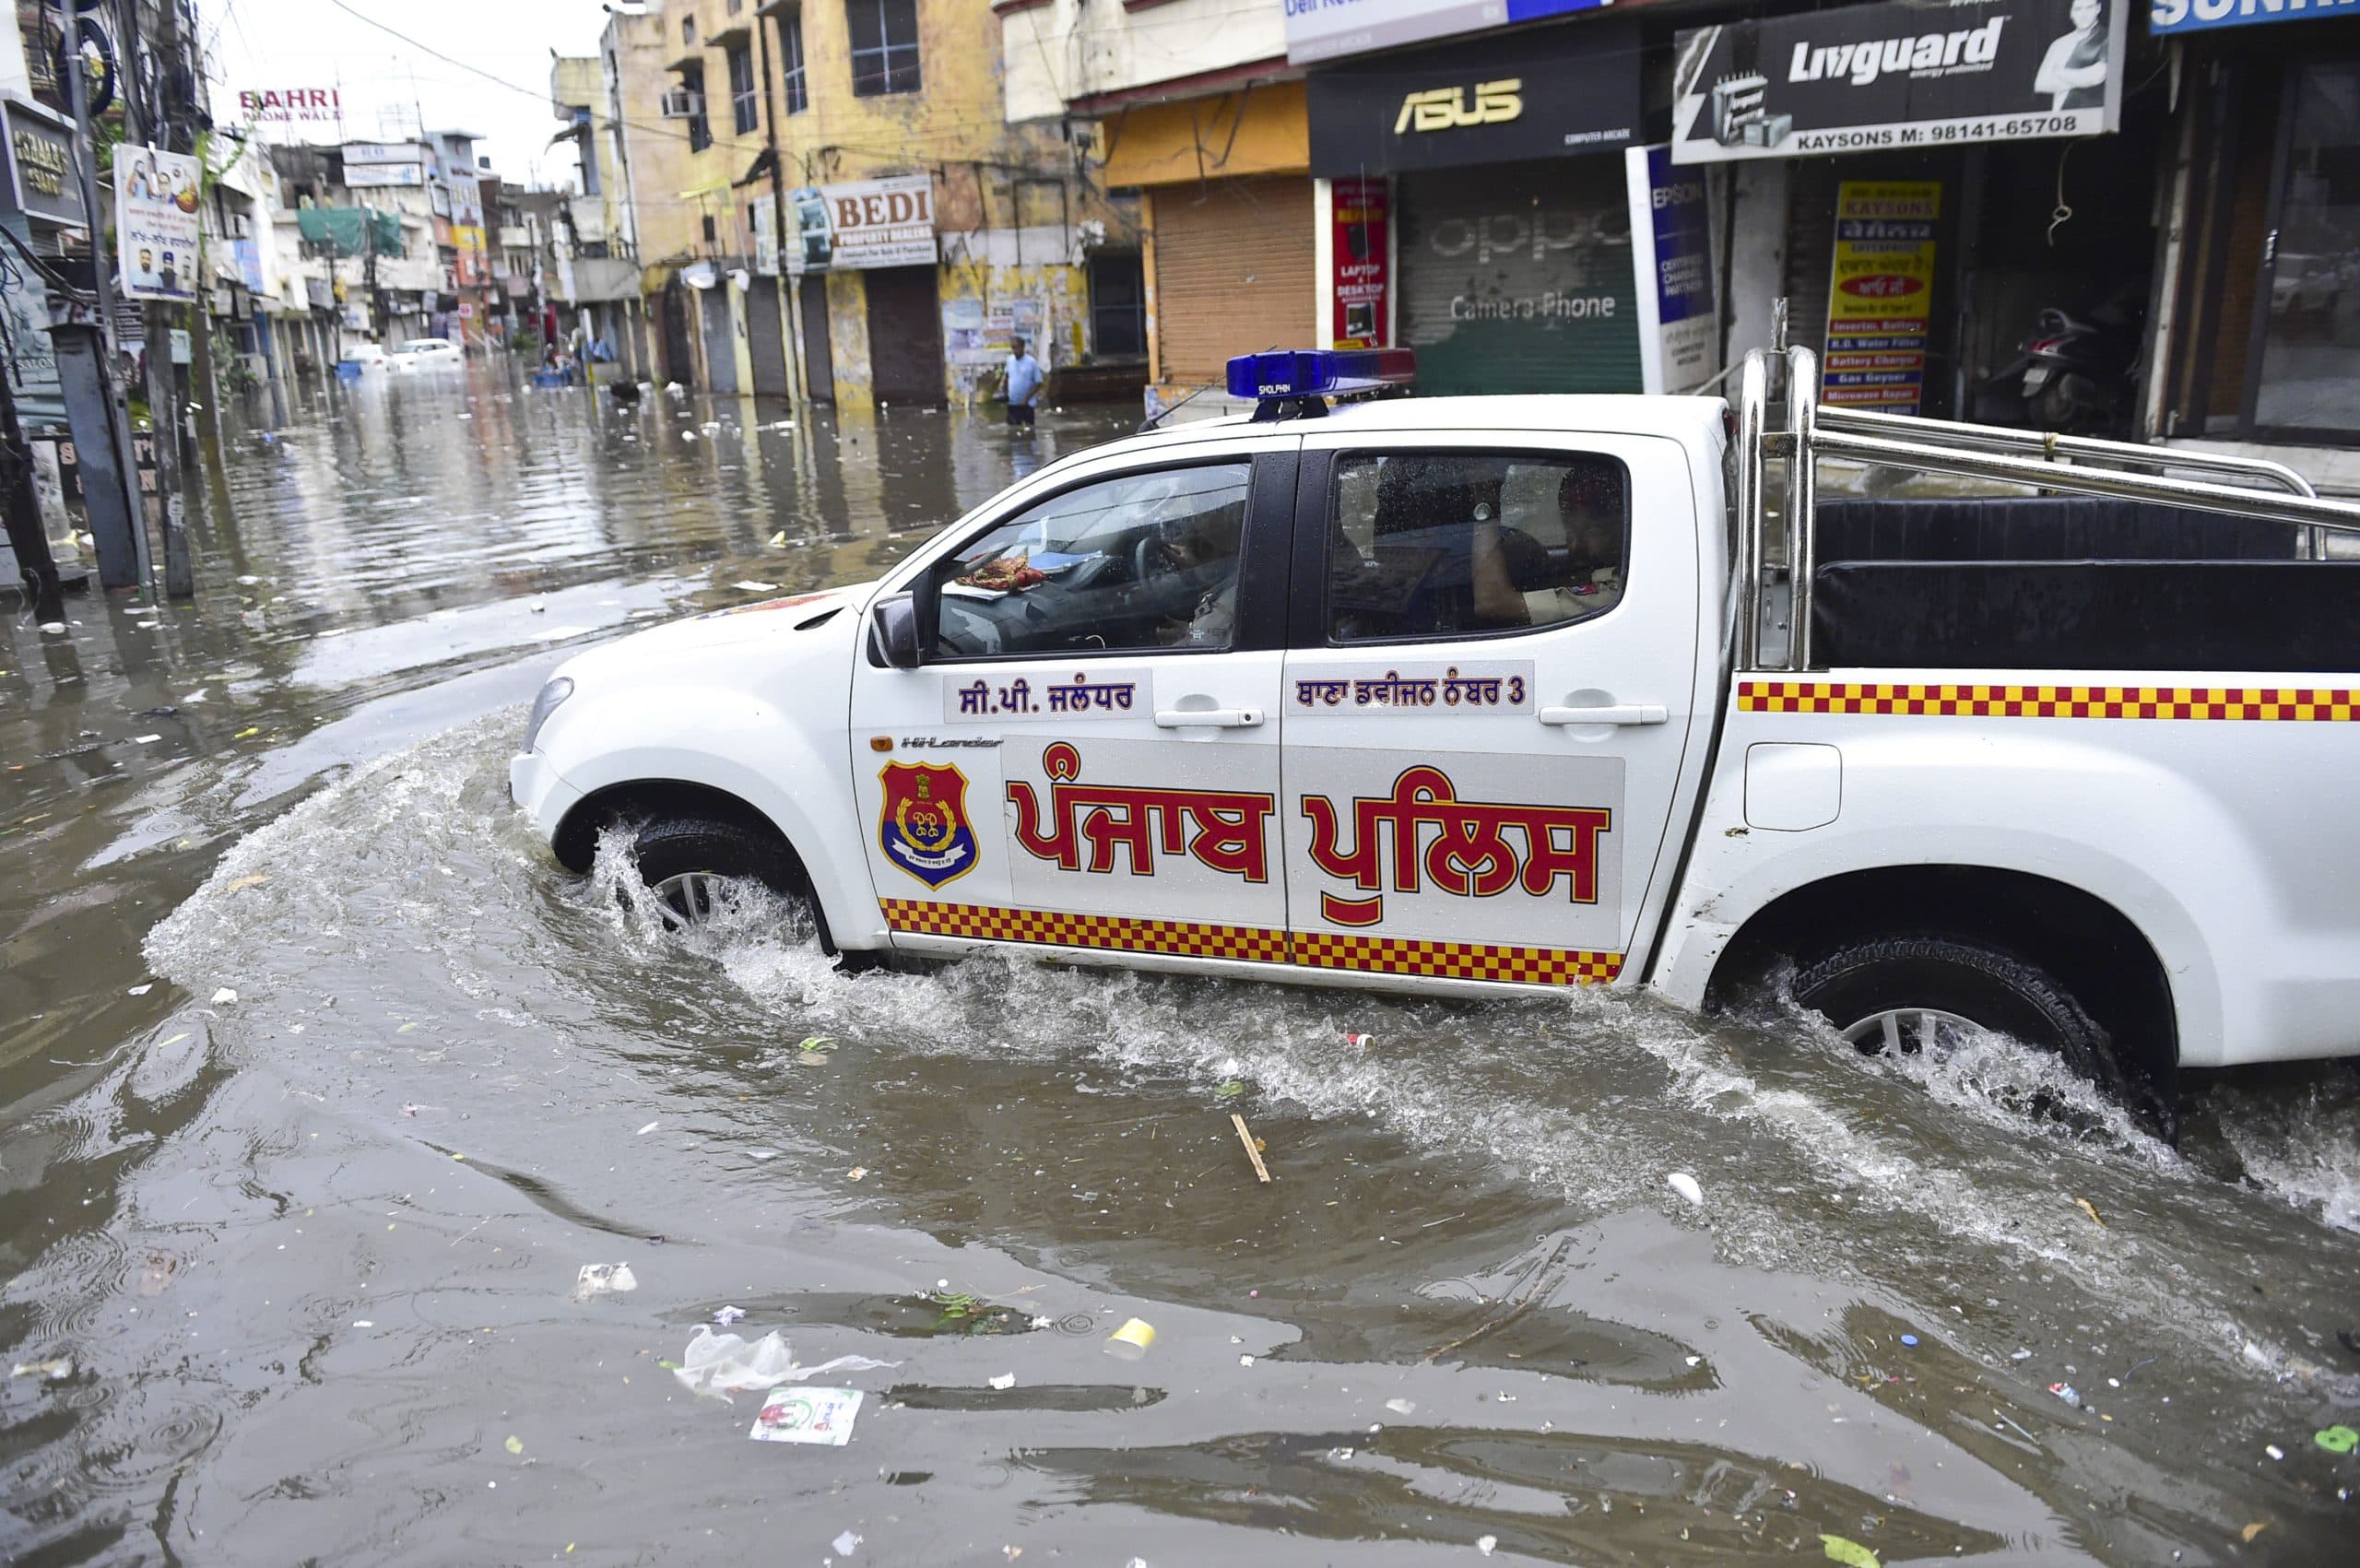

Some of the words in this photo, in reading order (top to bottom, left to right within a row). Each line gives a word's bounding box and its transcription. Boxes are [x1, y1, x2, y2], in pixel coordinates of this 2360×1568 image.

[1909, 67, 1943, 79] energy
[1944, 61, 1993, 76] unlimited
[240, 88, 339, 109] BAHRI
[1394, 78, 1524, 135] ASUS
[1564, 131, 1602, 146] COMPUTER
[1798, 130, 1893, 150] KAYSONS
[1900, 128, 1924, 143] M:
[1930, 116, 2077, 142] 98141-65708
[1653, 184, 1704, 209] EPSON
[837, 192, 929, 228] BEDI
[1340, 265, 1380, 277] LAPTOP
[1337, 283, 1385, 297] DESKTOP
[1450, 296, 1534, 320] Camera
[1541, 291, 1616, 318] Phone
[1882, 320, 1922, 331] Battery
[1858, 338, 1890, 348] Water
[1832, 357, 1871, 367] Battery
[1873, 355, 1917, 366] Charger
[1838, 373, 1862, 383] Gas
[1866, 372, 1906, 383] Geyser
[1827, 391, 1880, 401] Microwave
[1882, 389, 1913, 399] Repair
[959, 678, 1040, 714] ਸੀ.ਪੀ.
[1047, 671, 1136, 712] ਜਲੰਧਰ
[1296, 679, 1351, 707] ਥਾਣਾ
[1354, 669, 1438, 707] ਡਵੀਜਨ
[1442, 666, 1503, 707] ਨੰਬਰ
[1507, 675, 1526, 706] 3
[1005, 741, 1275, 884] ਪੰਜਾਬ
[1300, 764, 1611, 927] ਪੁਲਿਸ
